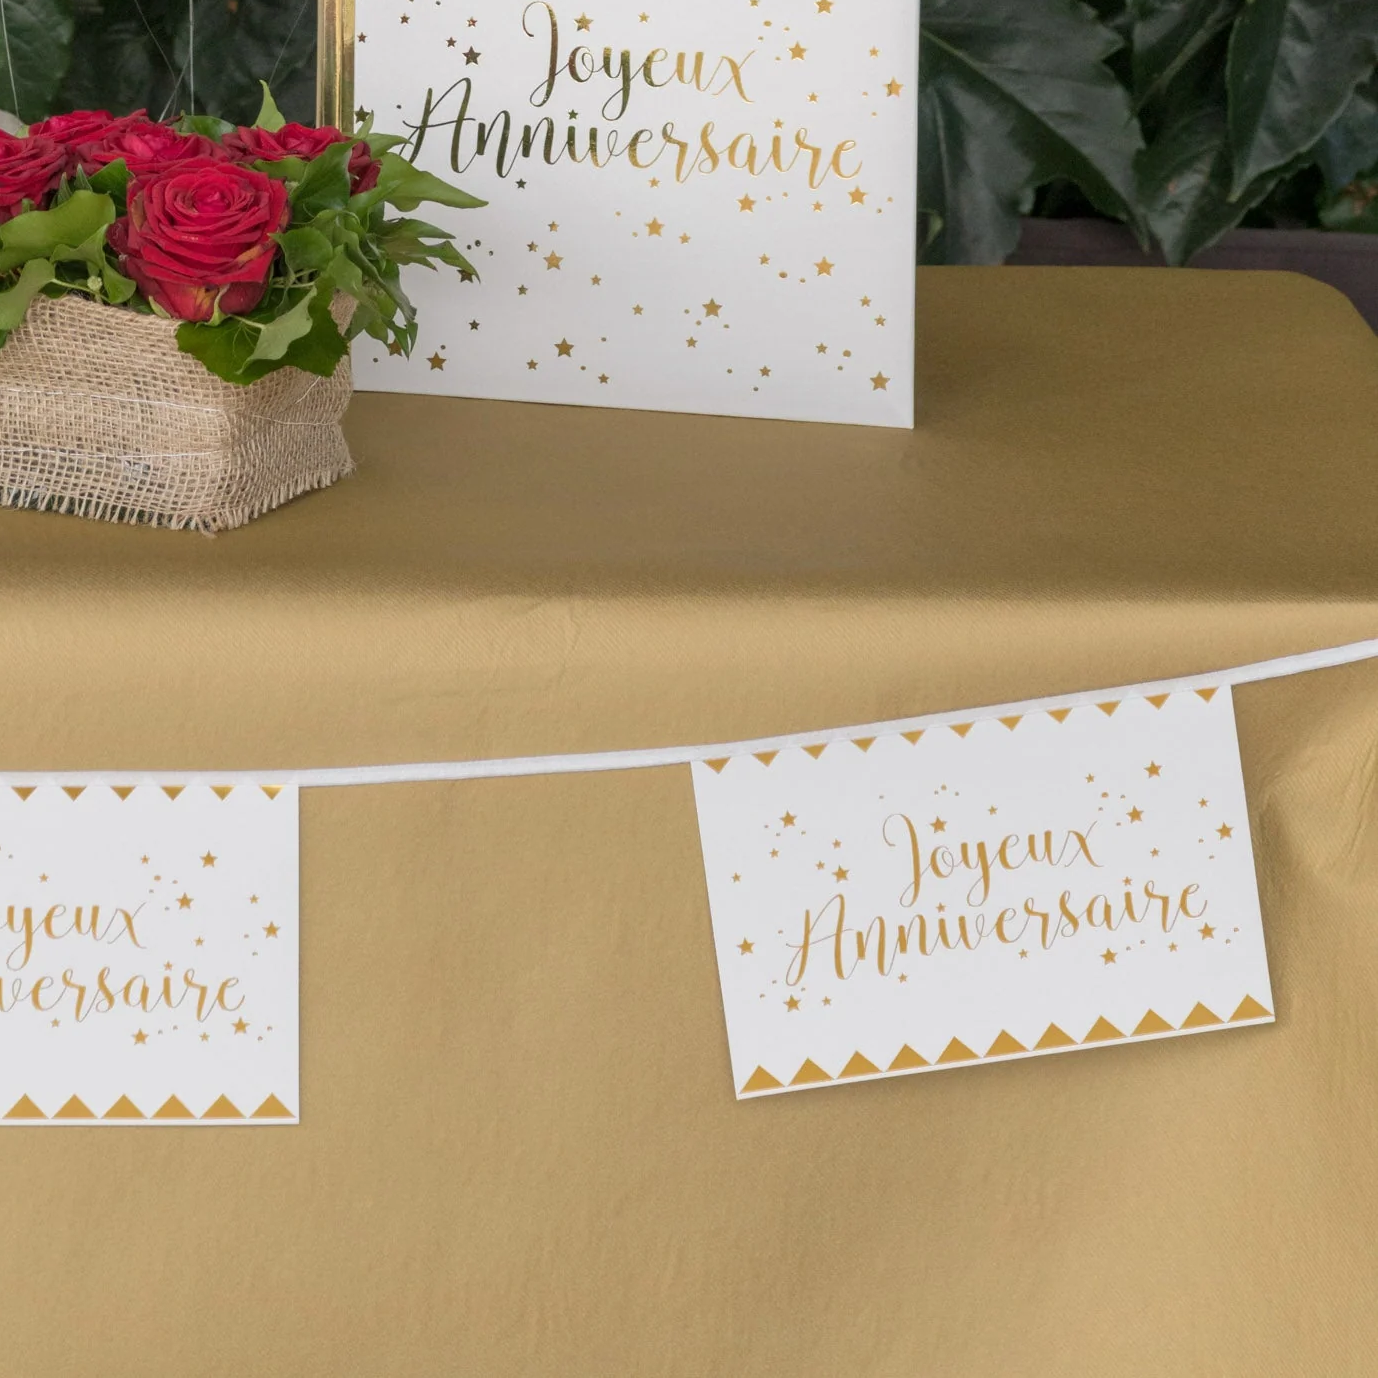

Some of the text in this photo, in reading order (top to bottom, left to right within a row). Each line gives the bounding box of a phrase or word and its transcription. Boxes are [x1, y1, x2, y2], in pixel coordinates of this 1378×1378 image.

[521, 0, 757, 122] Joyeux
[399, 76, 863, 191] Anniversaire
[882, 813, 1105, 908] Joyeux
[785, 880, 1208, 987] Anniversaire
